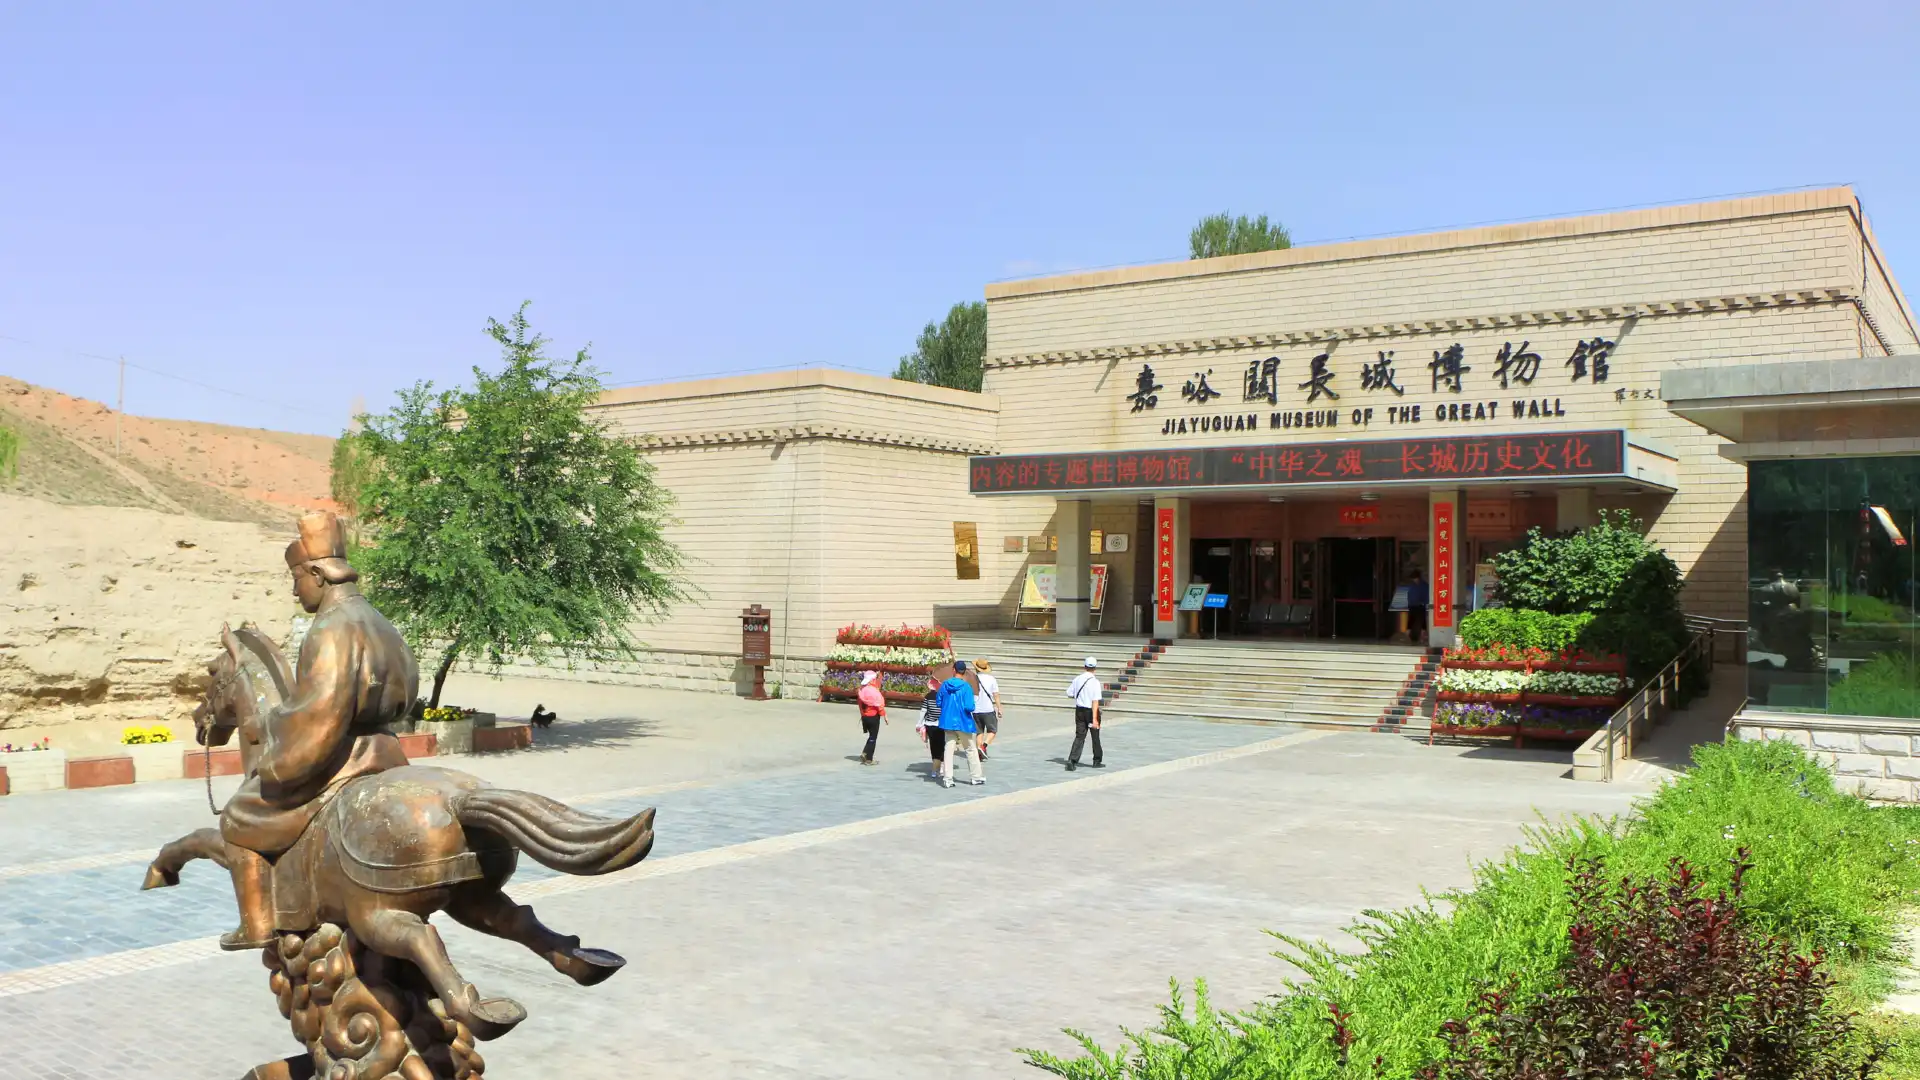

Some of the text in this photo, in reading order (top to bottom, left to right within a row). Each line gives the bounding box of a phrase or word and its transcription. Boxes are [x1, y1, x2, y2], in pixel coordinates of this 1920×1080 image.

[1162, 399, 1566, 435] JIAYUGUAN MUSEUM OF THE GREAT WALL
